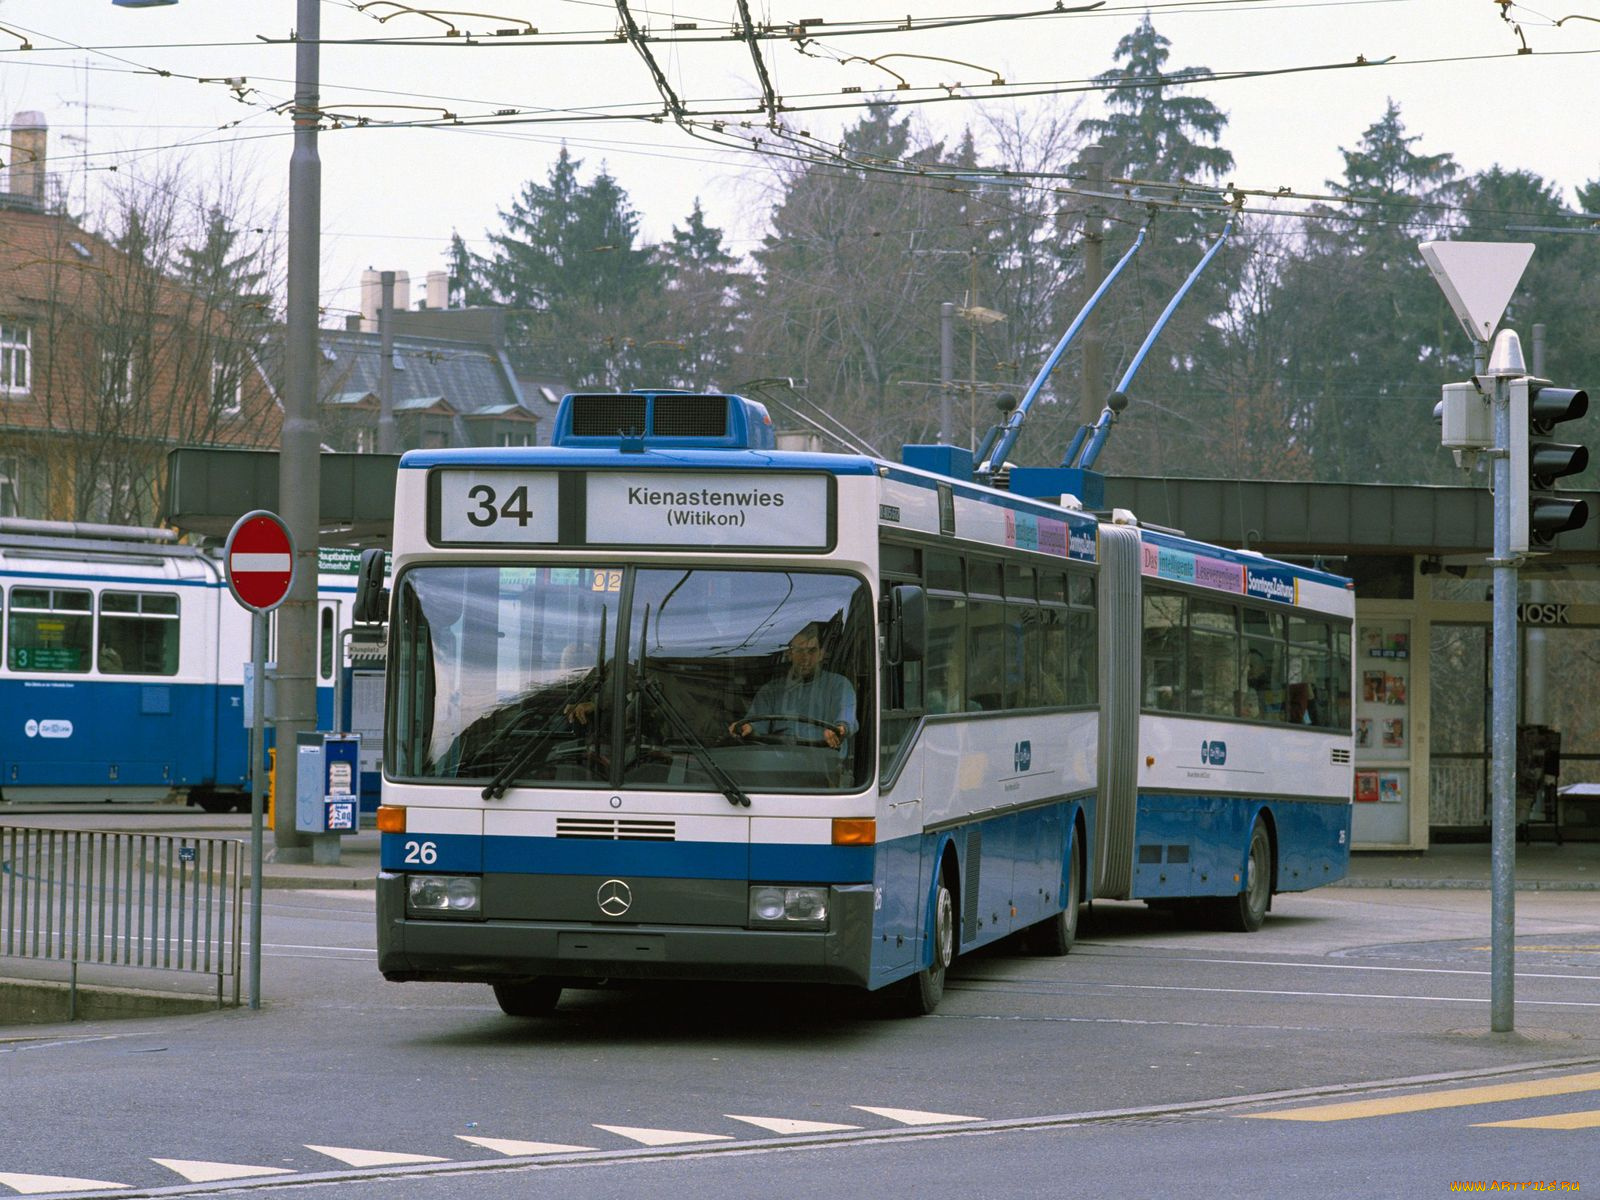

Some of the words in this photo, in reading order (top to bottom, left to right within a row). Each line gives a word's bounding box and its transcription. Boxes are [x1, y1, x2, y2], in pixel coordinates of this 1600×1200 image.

[466, 484, 534, 527] 34
[628, 486, 785, 507] Kienastenwies
[666, 509, 746, 527] (Witikon)
[1144, 548, 1158, 569] Das
[1248, 571, 1294, 602] SonntagsZeitung
[1517, 603, 1569, 624] IOSK
[18, 649, 28, 666] 3
[404, 840, 437, 865] 26
